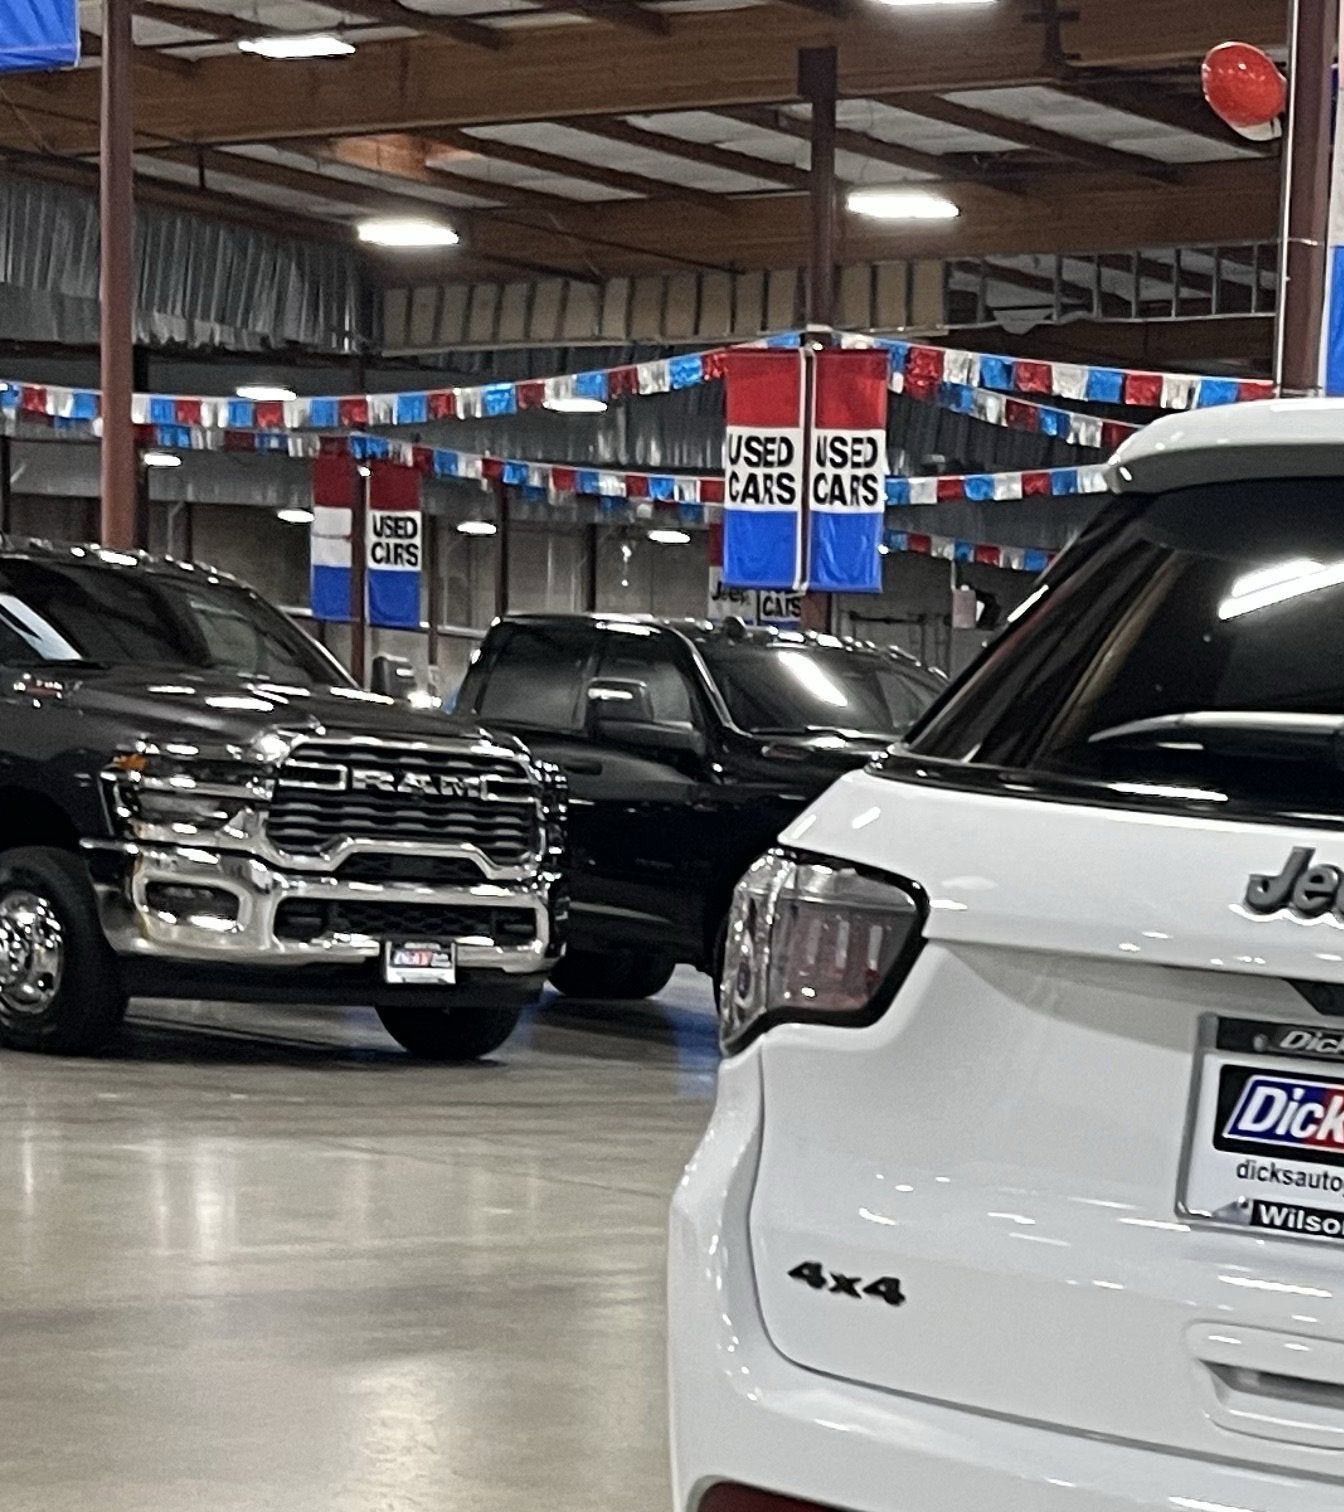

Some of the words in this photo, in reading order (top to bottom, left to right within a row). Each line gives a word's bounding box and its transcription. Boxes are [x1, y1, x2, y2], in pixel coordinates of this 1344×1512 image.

[728, 434, 795, 468] USED
[815, 436, 878, 469] USED
[728, 471, 796, 505] CARS
[813, 472, 878, 506] CARS
[373, 514, 418, 539] USED
[352, 768, 481, 797] RAM
[787, 1261, 906, 1307] 4x4
